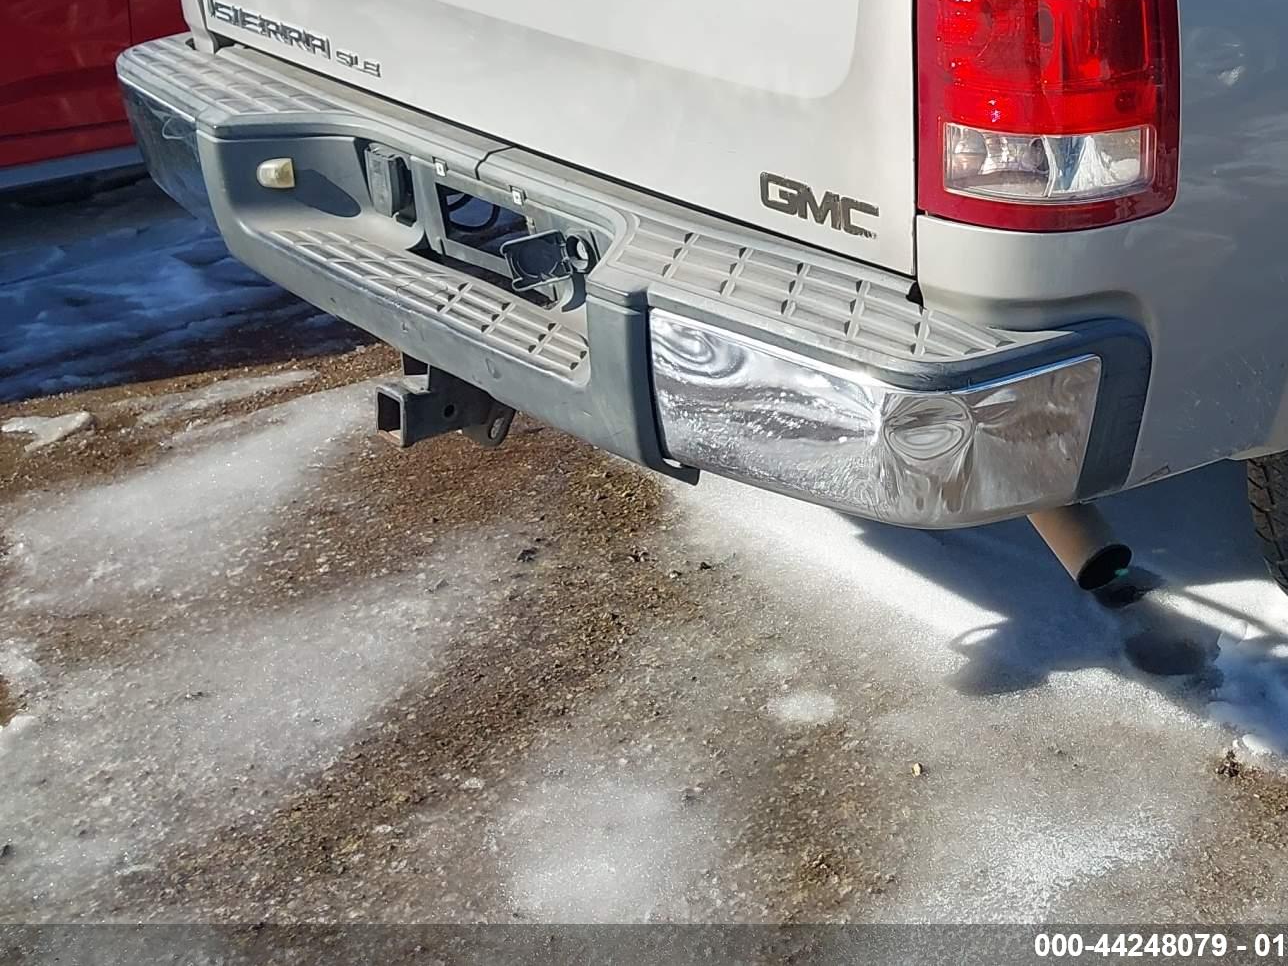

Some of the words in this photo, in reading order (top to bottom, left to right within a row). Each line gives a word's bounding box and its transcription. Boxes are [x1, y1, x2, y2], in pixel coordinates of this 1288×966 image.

[214, 1, 333, 60] SIERRA
[336, 49, 383, 79] SLE
[760, 171, 880, 240] GMC
